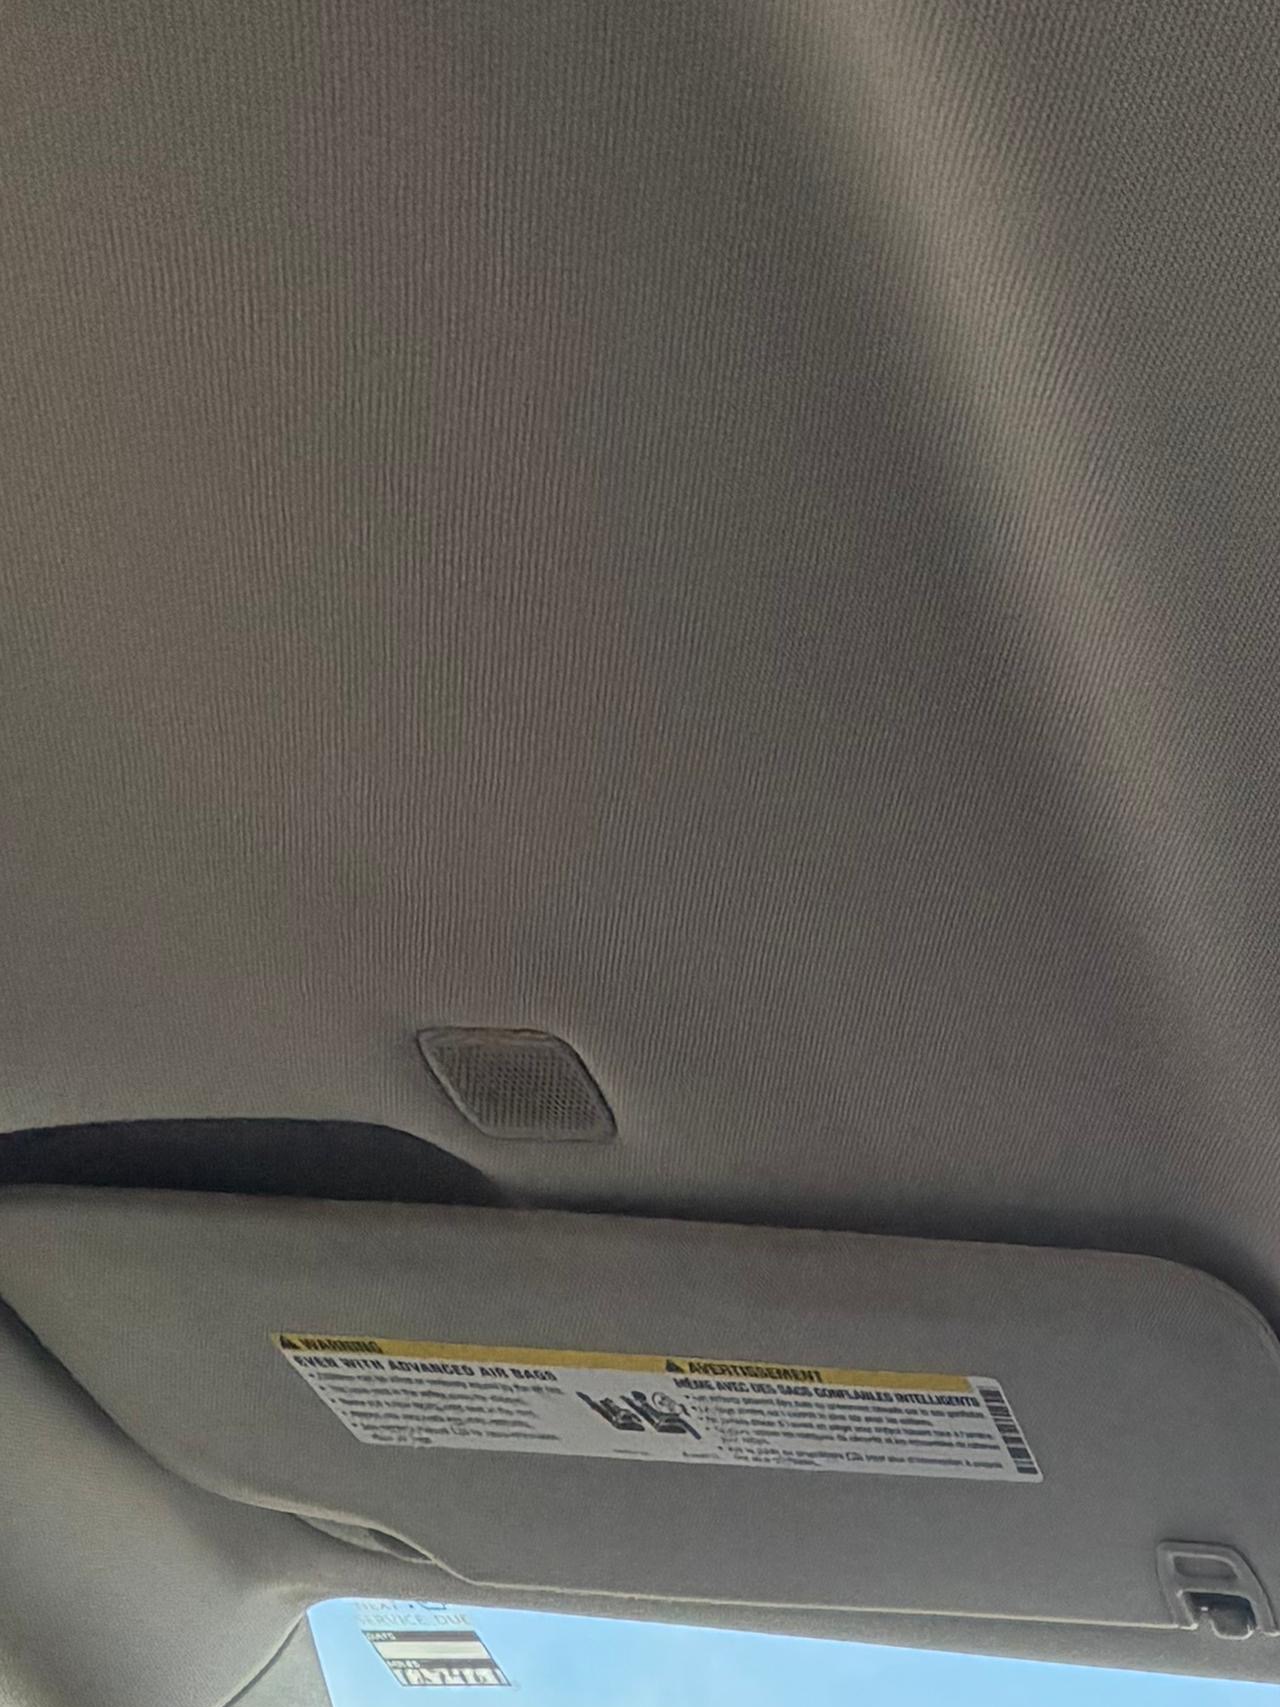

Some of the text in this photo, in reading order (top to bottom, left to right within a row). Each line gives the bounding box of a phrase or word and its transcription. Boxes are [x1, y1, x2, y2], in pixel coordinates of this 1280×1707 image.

[342, 1357, 384, 1371] WITH
[388, 1360, 475, 1377] ADVANCED
[480, 1365, 509, 1379] AIR
